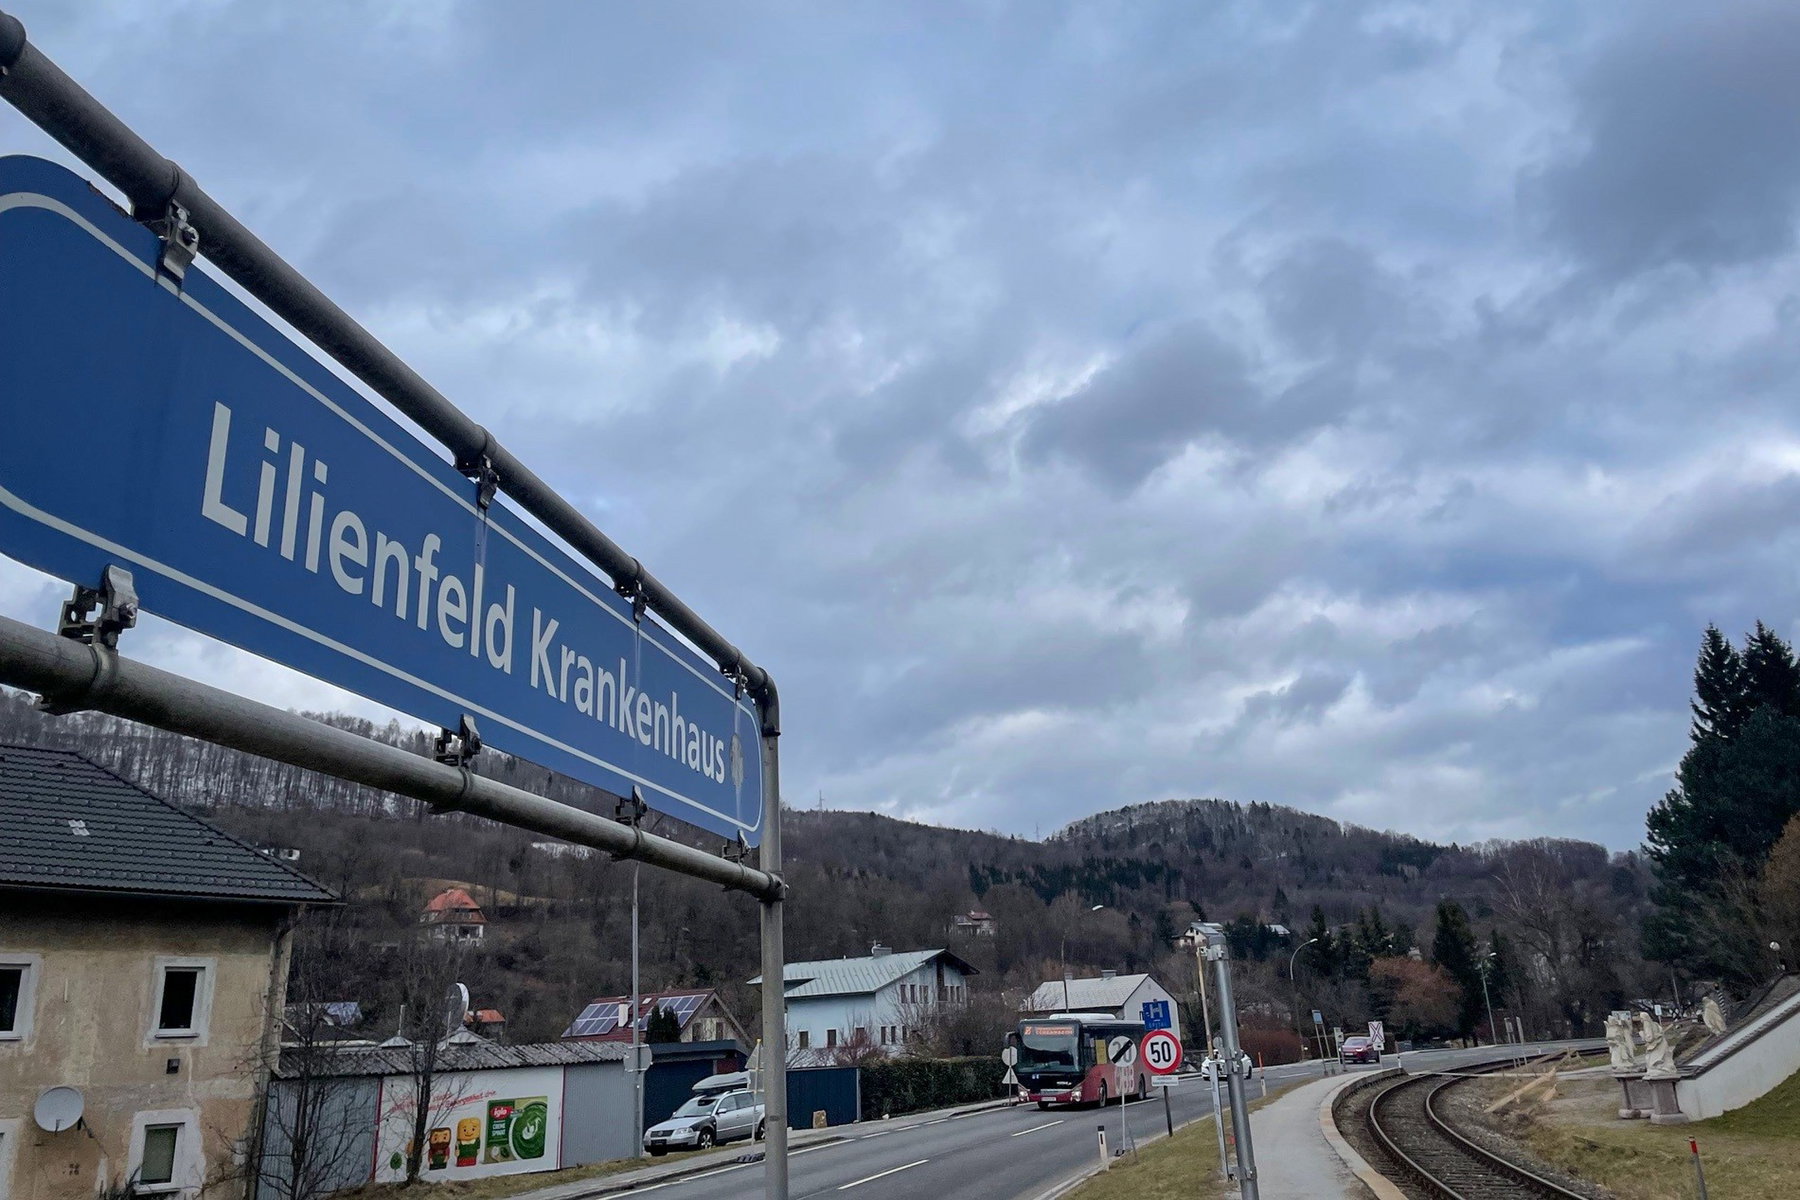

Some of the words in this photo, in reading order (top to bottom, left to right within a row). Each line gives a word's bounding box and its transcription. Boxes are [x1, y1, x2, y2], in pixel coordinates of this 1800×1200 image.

[202, 401, 515, 675] Lilienfeld
[530, 606, 725, 784] Krankenhaus
[1149, 1003, 1164, 1019] H
[1150, 1041, 1172, 1063] 50
[494, 1107, 507, 1118] iglo
